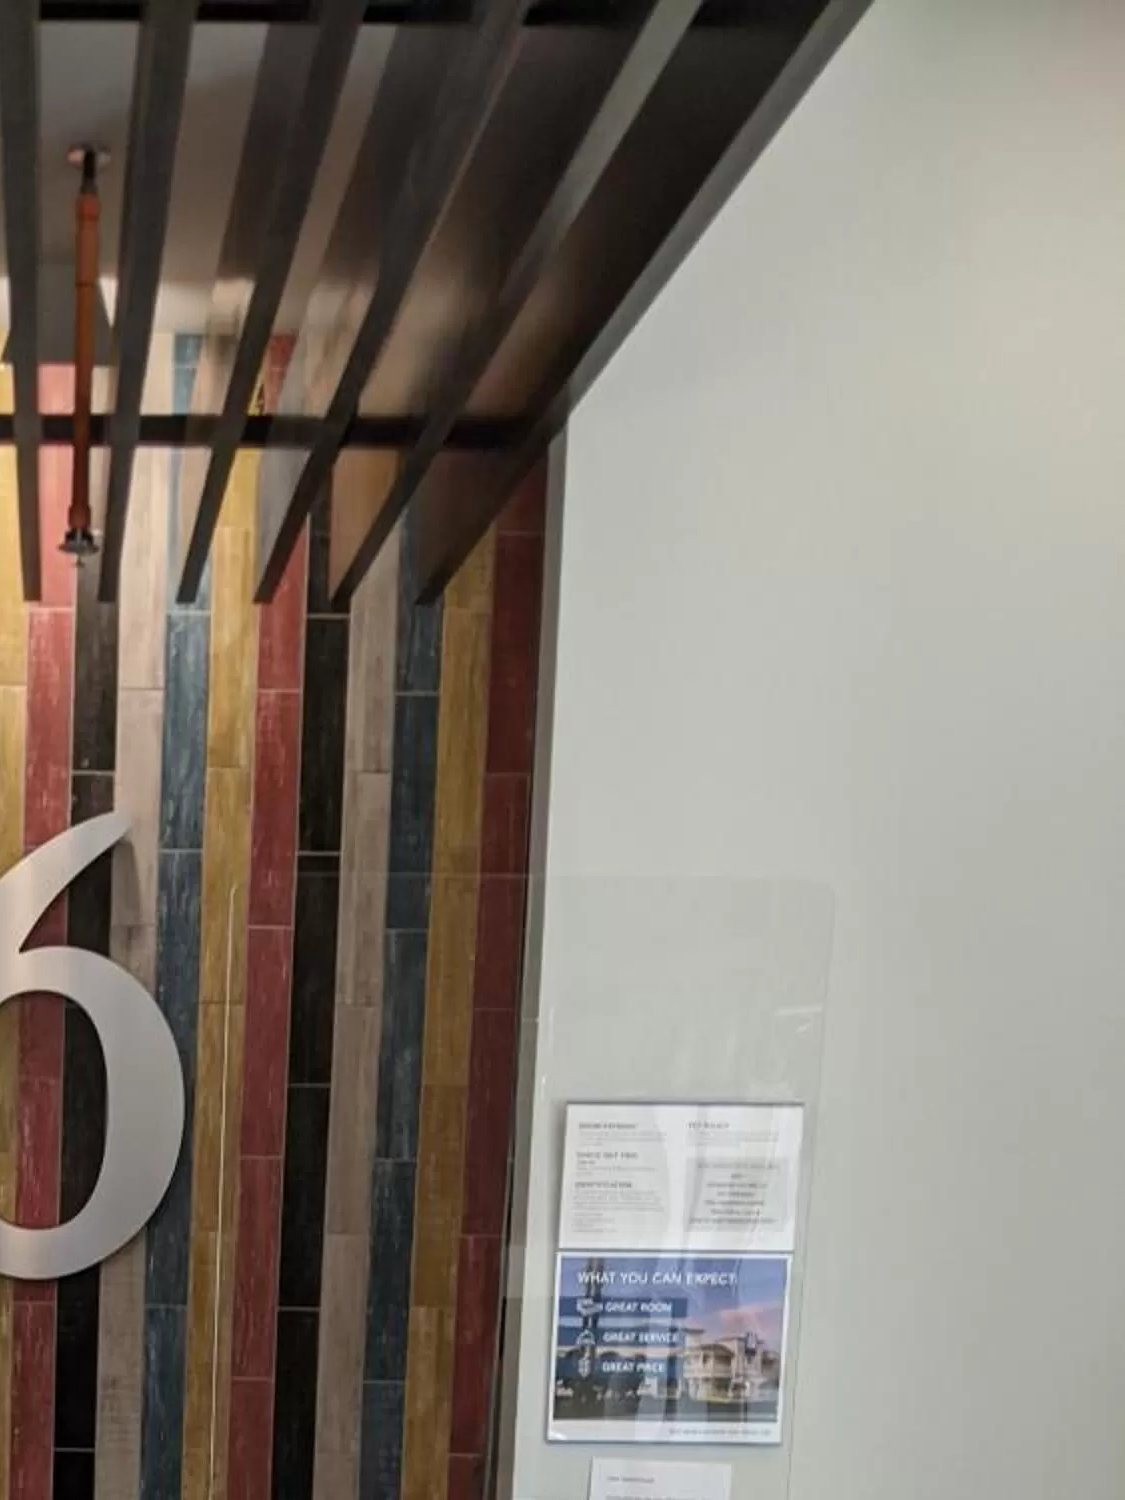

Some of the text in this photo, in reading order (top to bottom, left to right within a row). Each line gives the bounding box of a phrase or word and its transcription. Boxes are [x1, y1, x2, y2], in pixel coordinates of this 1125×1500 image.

[577, 1271, 619, 1285] WHAT
[621, 1272, 648, 1285] YOU
[652, 1272, 682, 1285] CAN
[605, 1302, 672, 1313] GREAT ROOM
[602, 1332, 678, 1343] GREAT SERVICE
[602, 1362, 665, 1373] GREAT PRICE
